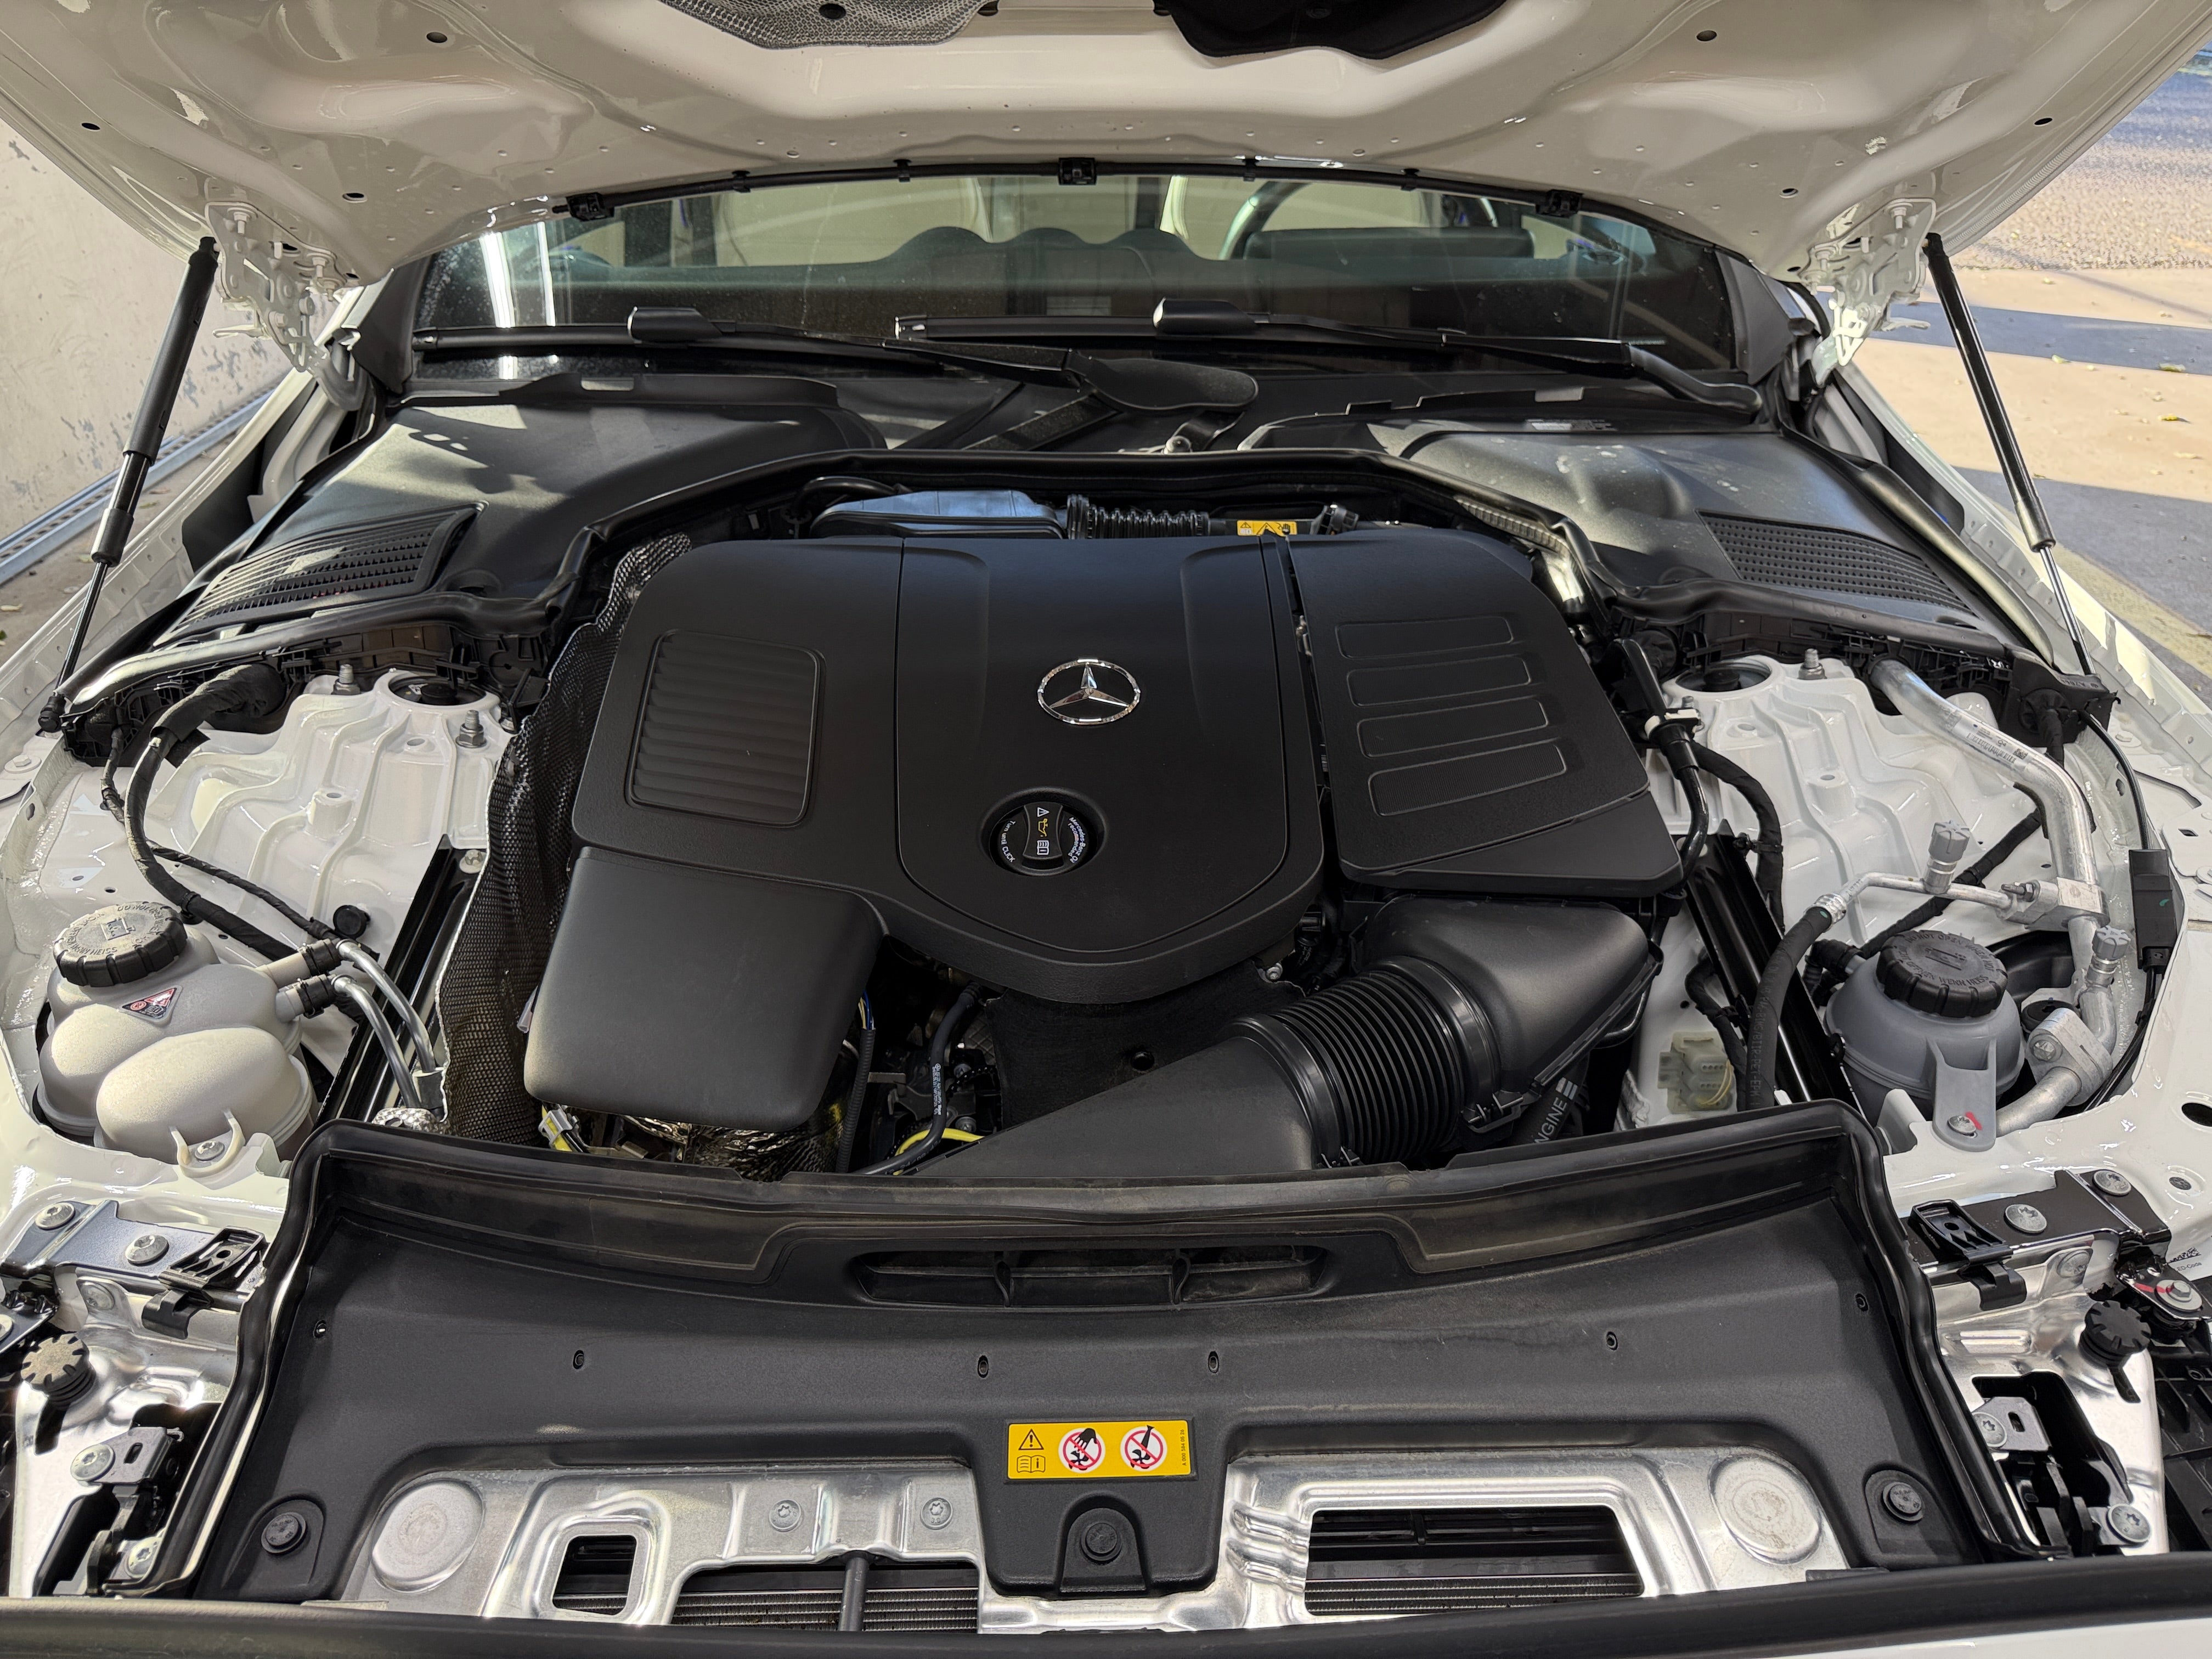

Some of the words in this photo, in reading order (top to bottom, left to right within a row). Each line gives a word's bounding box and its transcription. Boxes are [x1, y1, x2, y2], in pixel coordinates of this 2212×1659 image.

[1003, 820, 1016, 832] Turn
[1068, 823, 1079, 857] recommended
[1069, 817, 1086, 856] Mercedes-Benz
[1002, 846, 1016, 863] CLICK
[89, 946, 117, 955] HEISS
[1938, 934, 1963, 945] OPEN
[1965, 945, 1989, 959] WHEN
[1982, 960, 1995, 972] HOT
[1938, 976, 1967, 986] WENN
[1966, 974, 1989, 986] HEISS
[1534, 1097, 1568, 1143] NGINE
[2176, 1262, 2203, 1272] ED-Code
